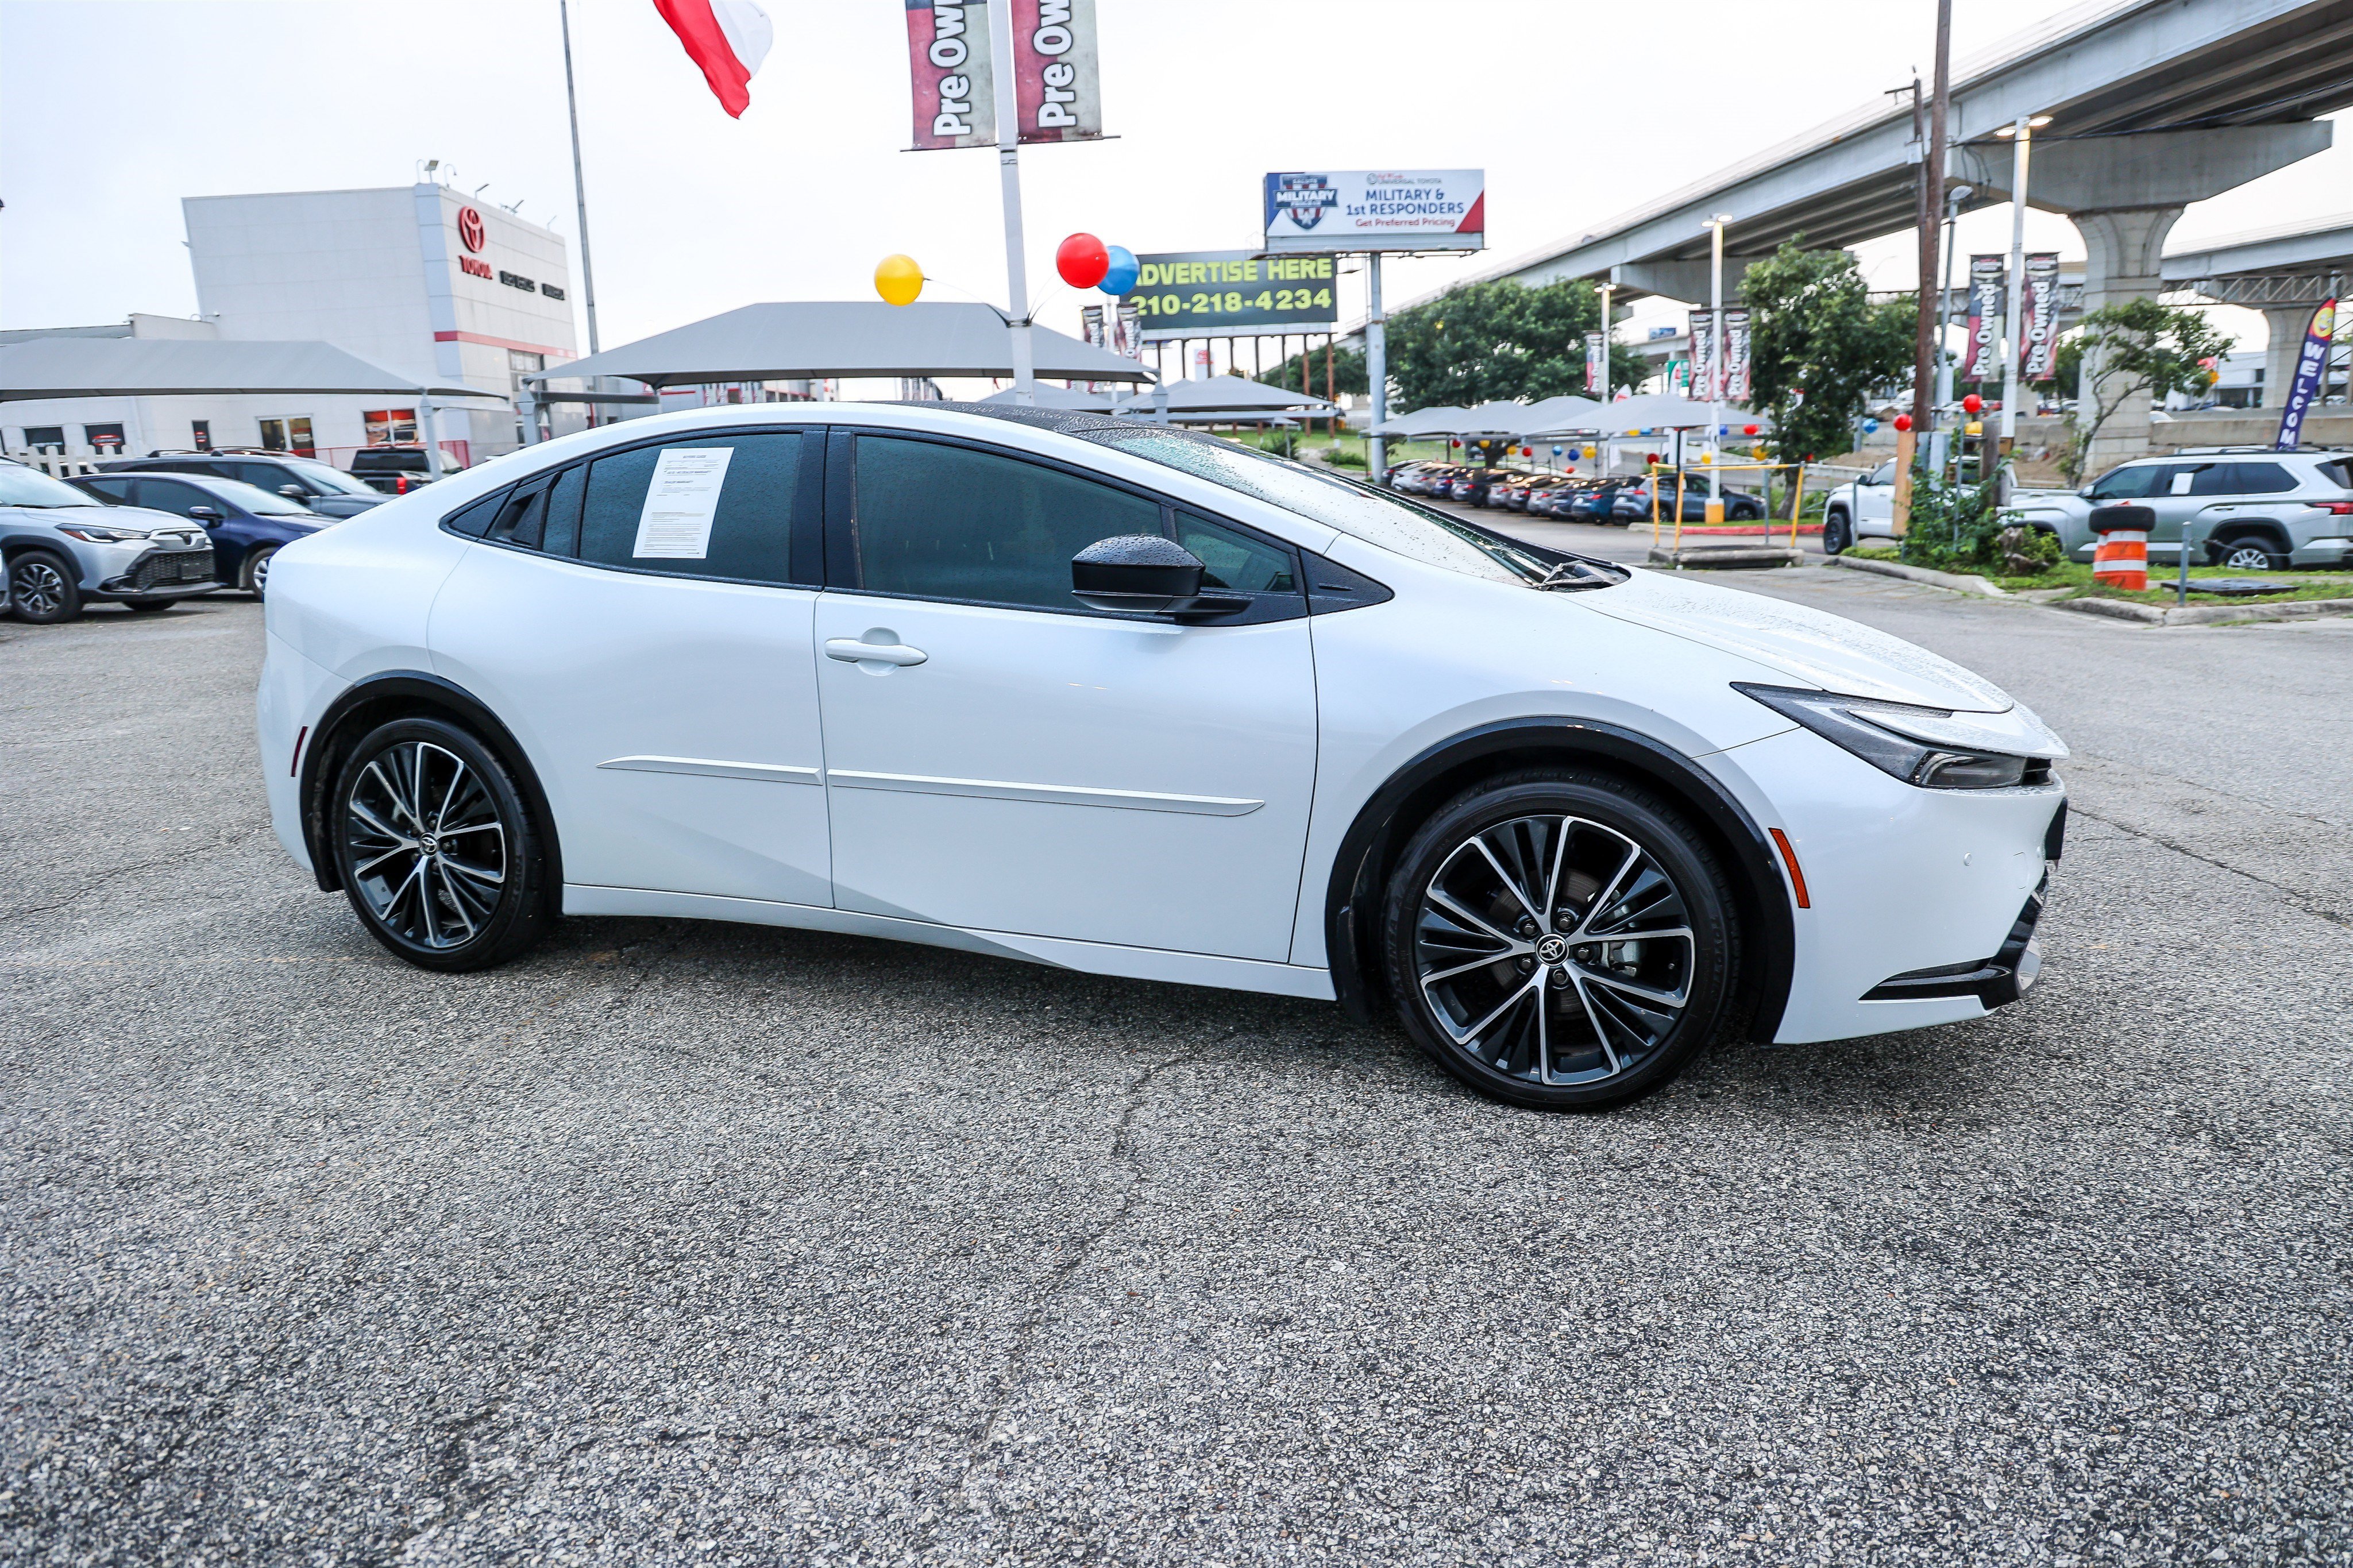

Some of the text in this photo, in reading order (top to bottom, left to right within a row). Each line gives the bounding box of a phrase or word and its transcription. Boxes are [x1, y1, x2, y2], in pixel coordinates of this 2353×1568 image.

[928, 0, 971, 136] Pre Ow
[1037, 63, 1077, 128] Pre
[1276, 189, 1336, 203] MILITARY
[1346, 202, 1464, 215] 1st RESPONDERS
[1365, 188, 1445, 201] MILITARY &
[1355, 217, 1455, 227] Get Preferred Pricing
[1267, 258, 1333, 281] HERE
[1129, 288, 1332, 316] 210-218-4234
[1975, 283, 1997, 345] Owned
[2029, 281, 2050, 342] Owned
[1693, 330, 1707, 374] Owned
[1728, 329, 1743, 374] Owned
[1970, 345, 1991, 376] Pre
[2025, 344, 2046, 373] Pre
[2279, 341, 2325, 450] WELCOM
